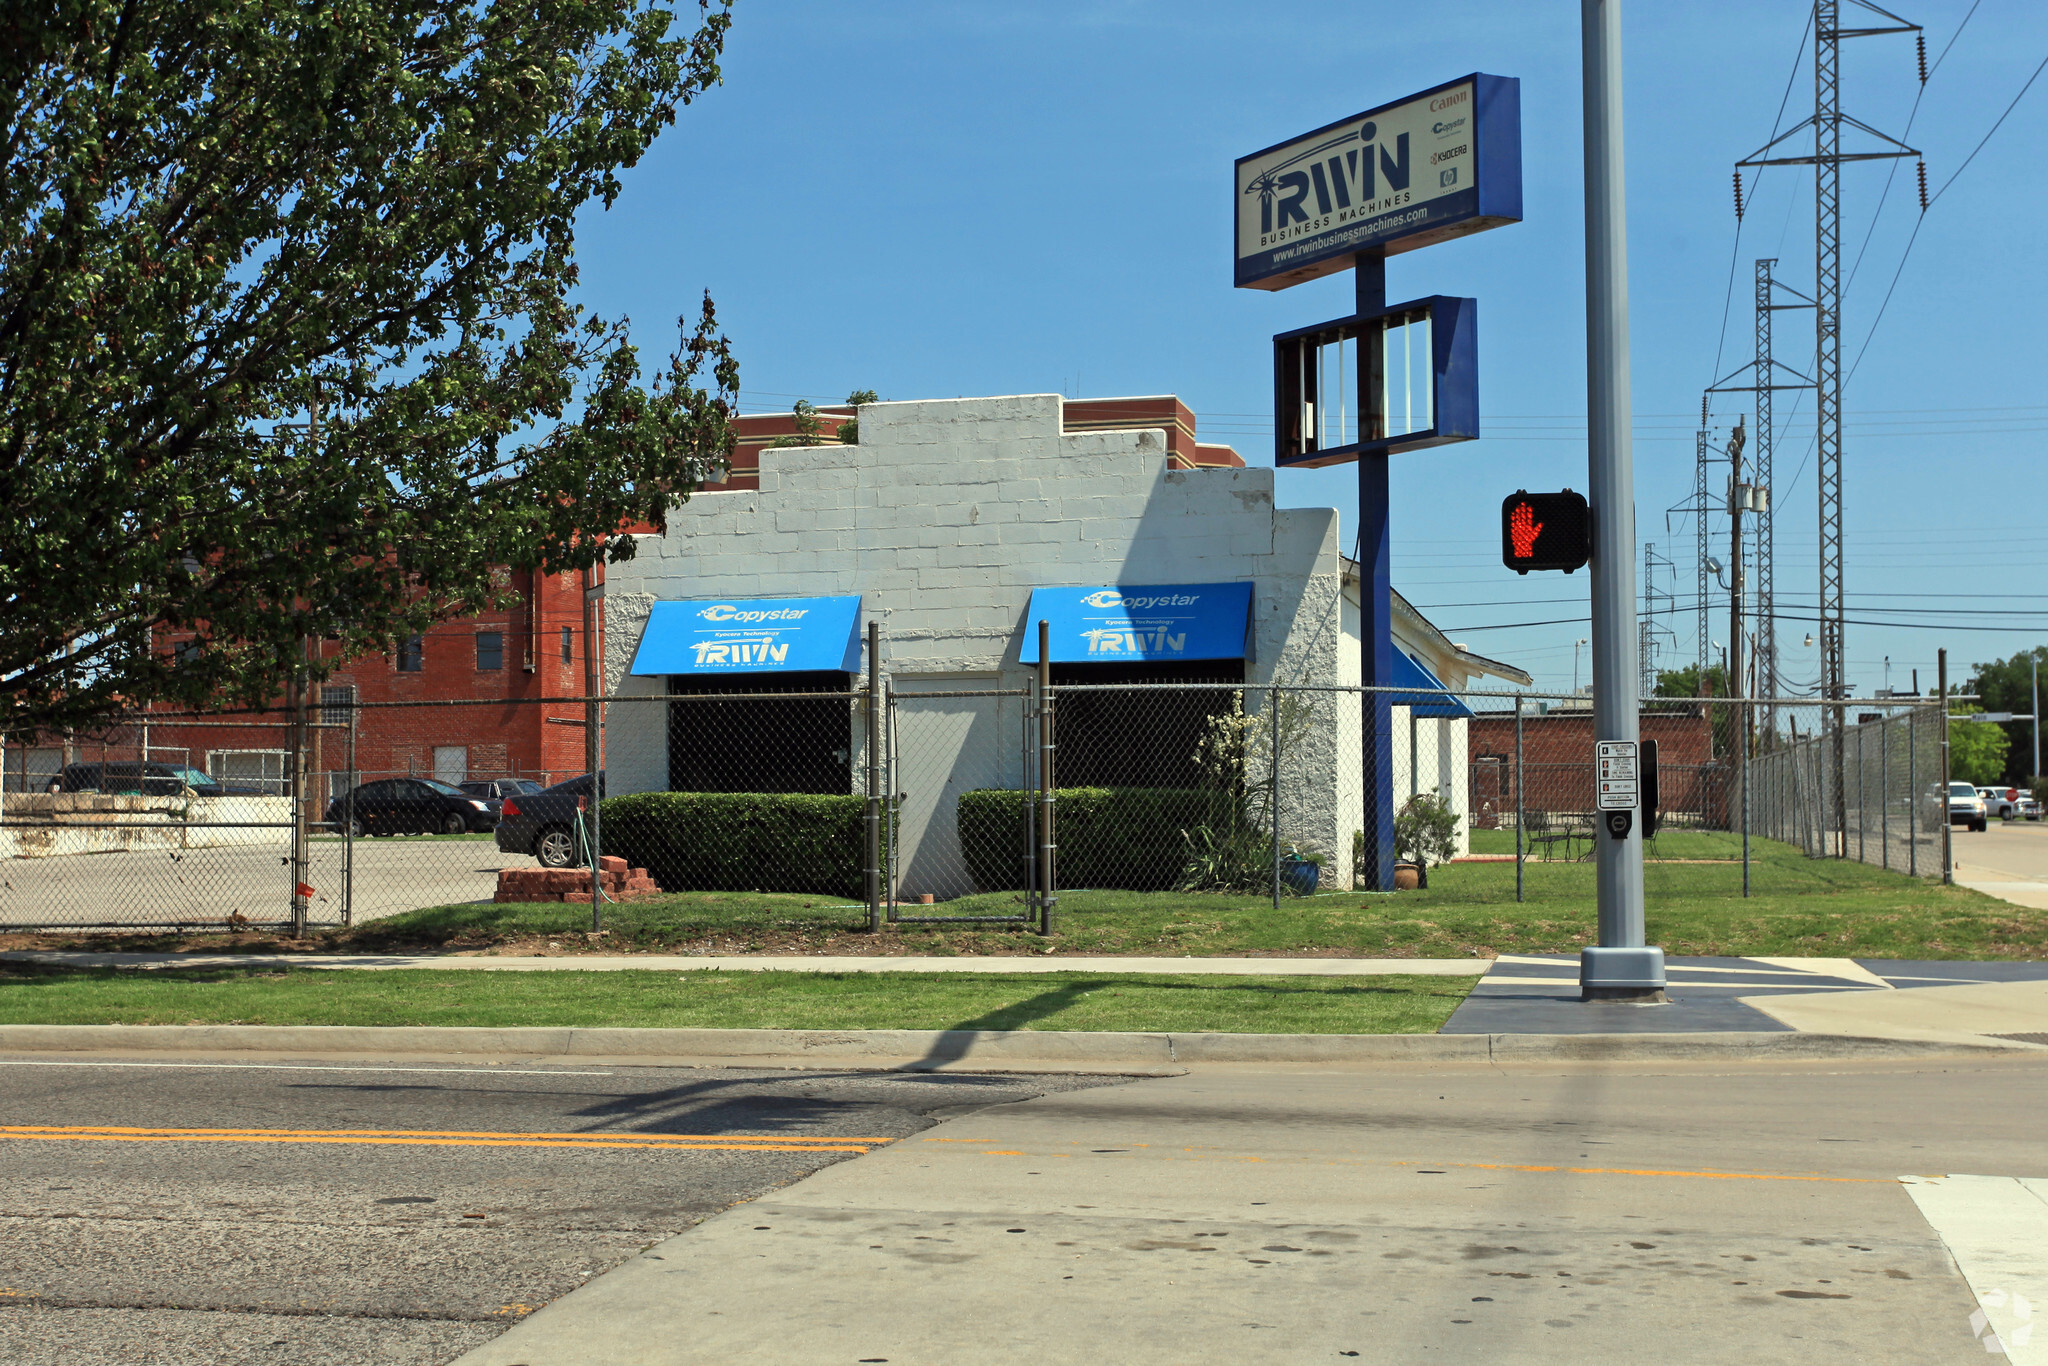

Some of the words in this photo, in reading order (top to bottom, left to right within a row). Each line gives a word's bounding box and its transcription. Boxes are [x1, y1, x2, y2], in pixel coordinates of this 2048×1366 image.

[1429, 90, 1467, 112] Canon
[1431, 117, 1466, 135] Copystar
[1437, 144, 1467, 162] KYOCERA
[1260, 216, 1330, 247] BUSINESS
[1339, 192, 1411, 223] MACHINES
[1272, 207, 1428, 263] www.irwinbusinessmachines.com
[1087, 591, 1200, 609] Copystar
[702, 605, 809, 623] Copystar
